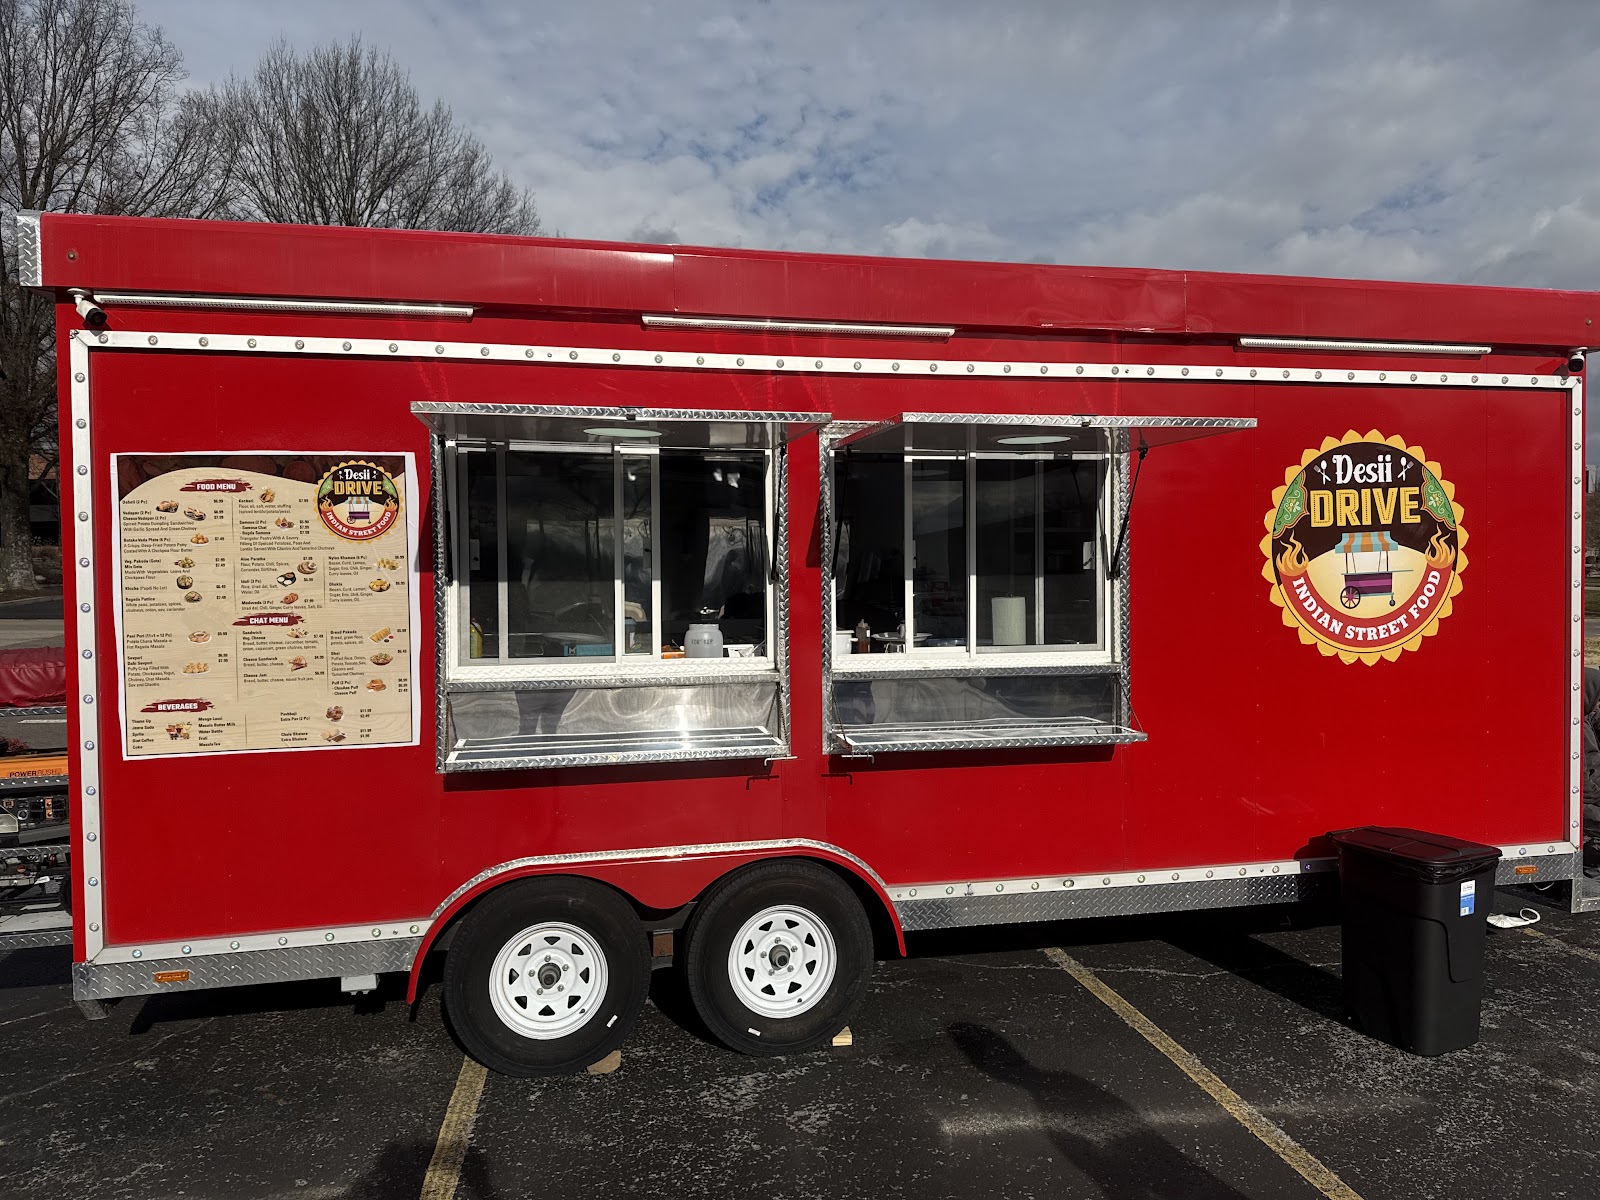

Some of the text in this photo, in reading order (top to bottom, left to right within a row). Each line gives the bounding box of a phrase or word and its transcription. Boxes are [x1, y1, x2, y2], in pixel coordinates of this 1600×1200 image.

[344, 469, 370, 480] Desii
[1332, 454, 1392, 484] Desii
[334, 481, 382, 495] DRIVE
[1310, 487, 1421, 527] DRIVE
[326, 512, 391, 536] INDIAN STREET FOOD
[1292, 570, 1441, 640] INDIAN STREET FOOD
